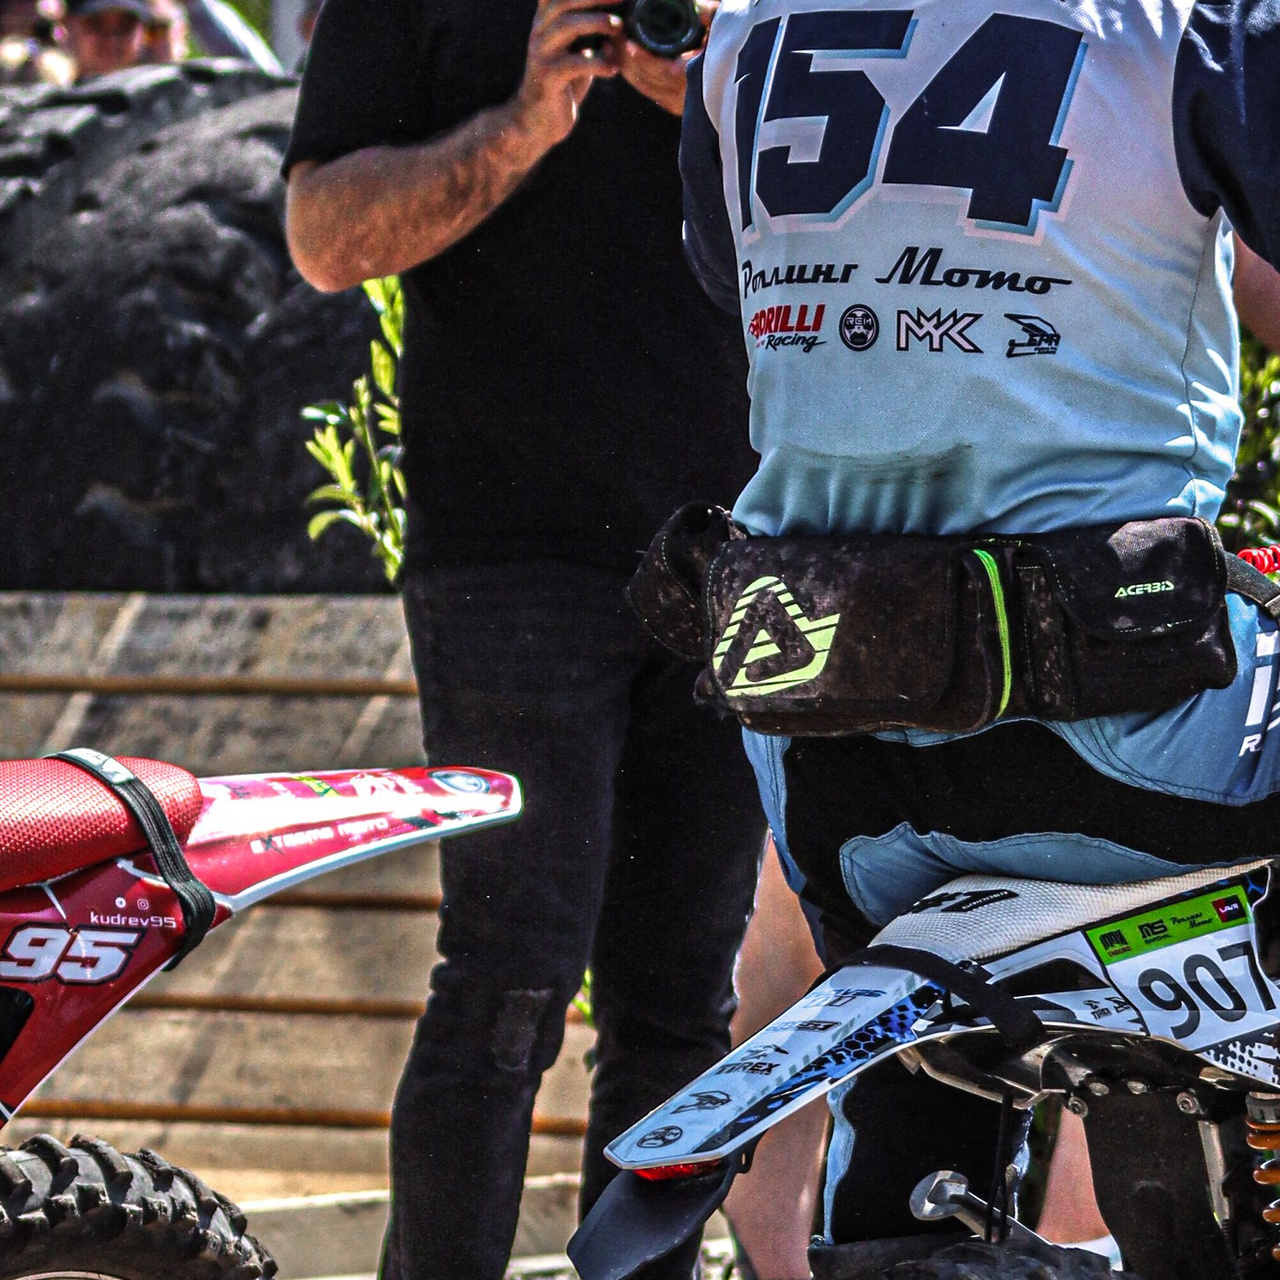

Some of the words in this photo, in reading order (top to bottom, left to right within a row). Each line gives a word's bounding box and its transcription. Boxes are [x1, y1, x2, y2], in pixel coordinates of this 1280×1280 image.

[733, 9, 1088, 236] 154
[765, 333, 827, 353] Racing
[1114, 580, 1175, 598] ACERBIS
[90, 911, 177, 929] kudrev95
[0, 926, 143, 984] 95
[1138, 940, 1276, 1040] 907
